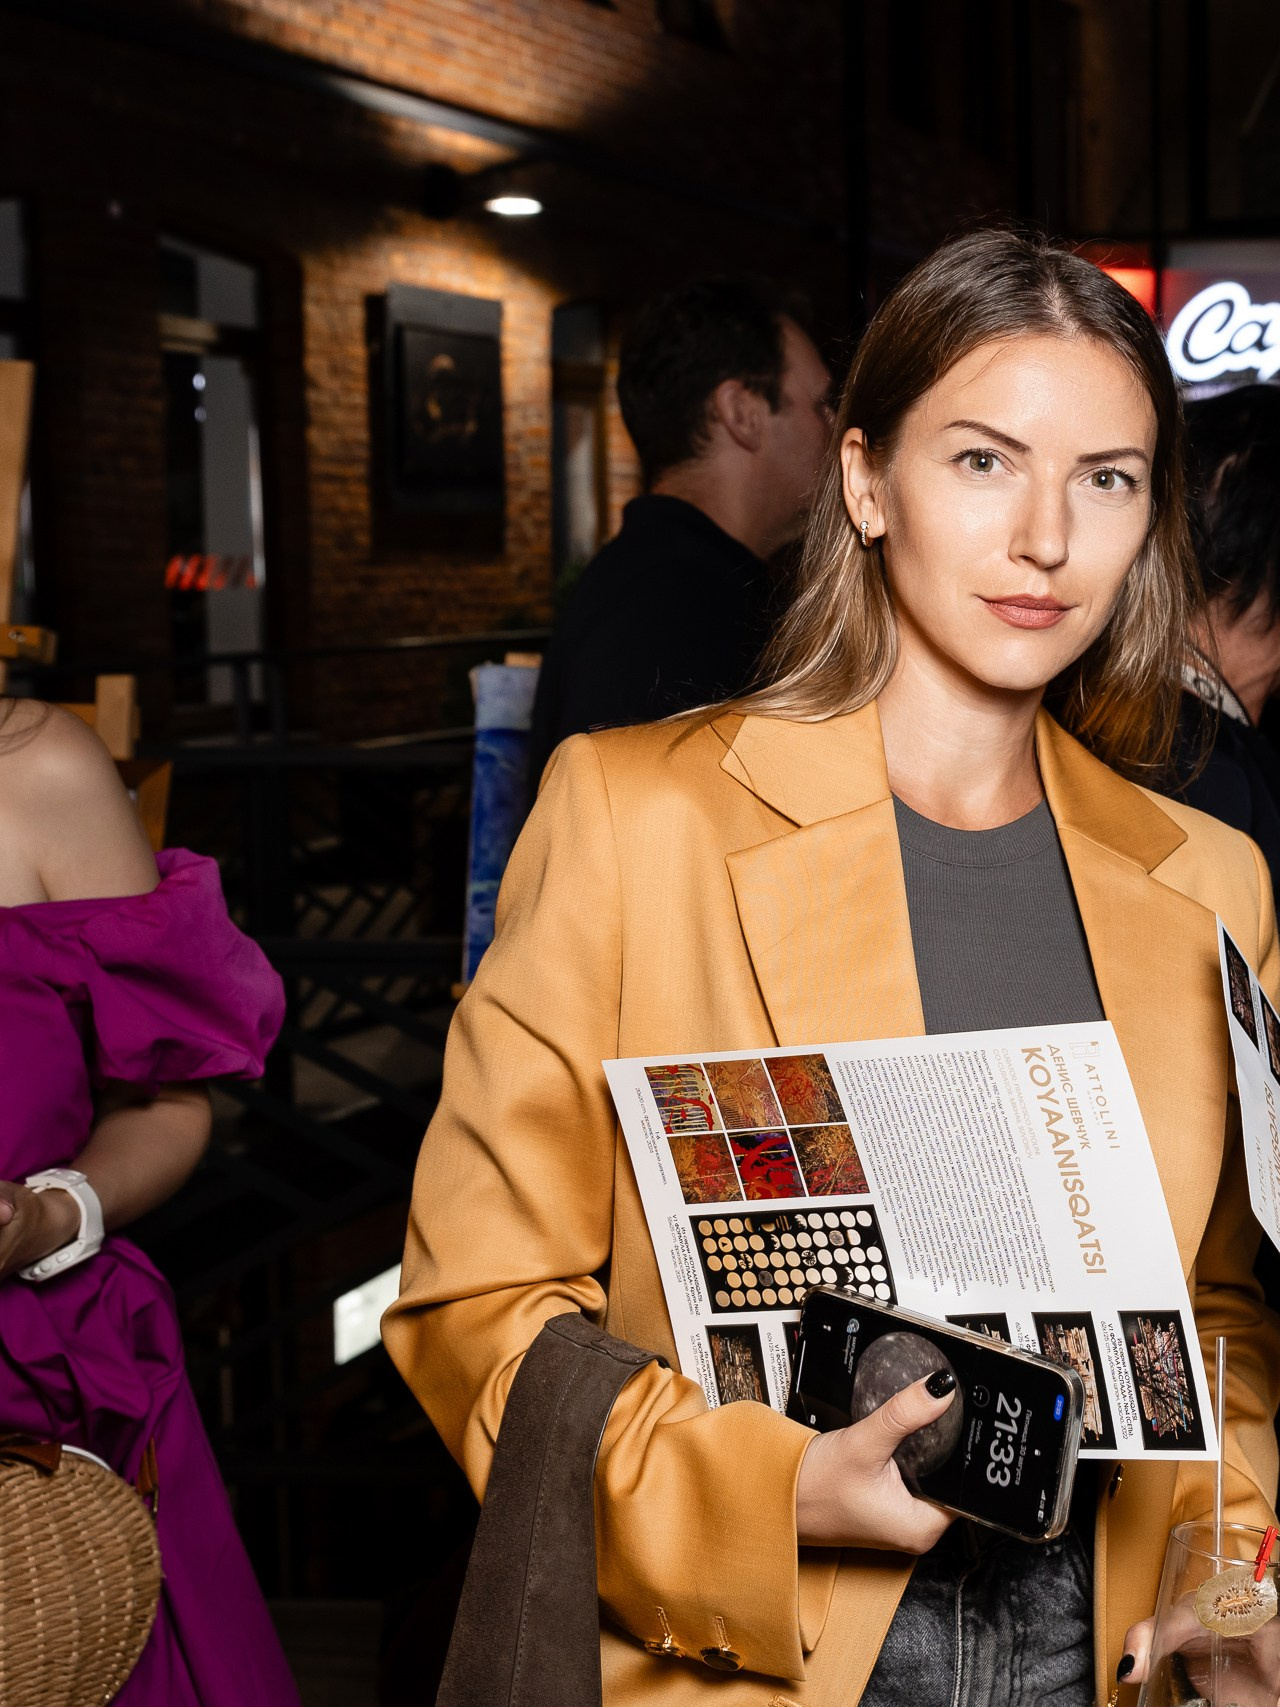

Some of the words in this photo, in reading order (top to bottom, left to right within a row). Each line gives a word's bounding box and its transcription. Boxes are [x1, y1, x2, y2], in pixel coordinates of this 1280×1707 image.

[1046, 1044, 1074, 1093] ДЕНИС
[1066, 1097, 1092, 1150] ШЕВЧУК
[1084, 1063, 1120, 1149] ATTOLINI
[1021, 1047, 1107, 1274] KOYAANISQATSI
[986, 1392, 1022, 1487] 21:33
[1015, 1456, 1024, 1486] августа
[1019, 1444, 1027, 1456] 30
